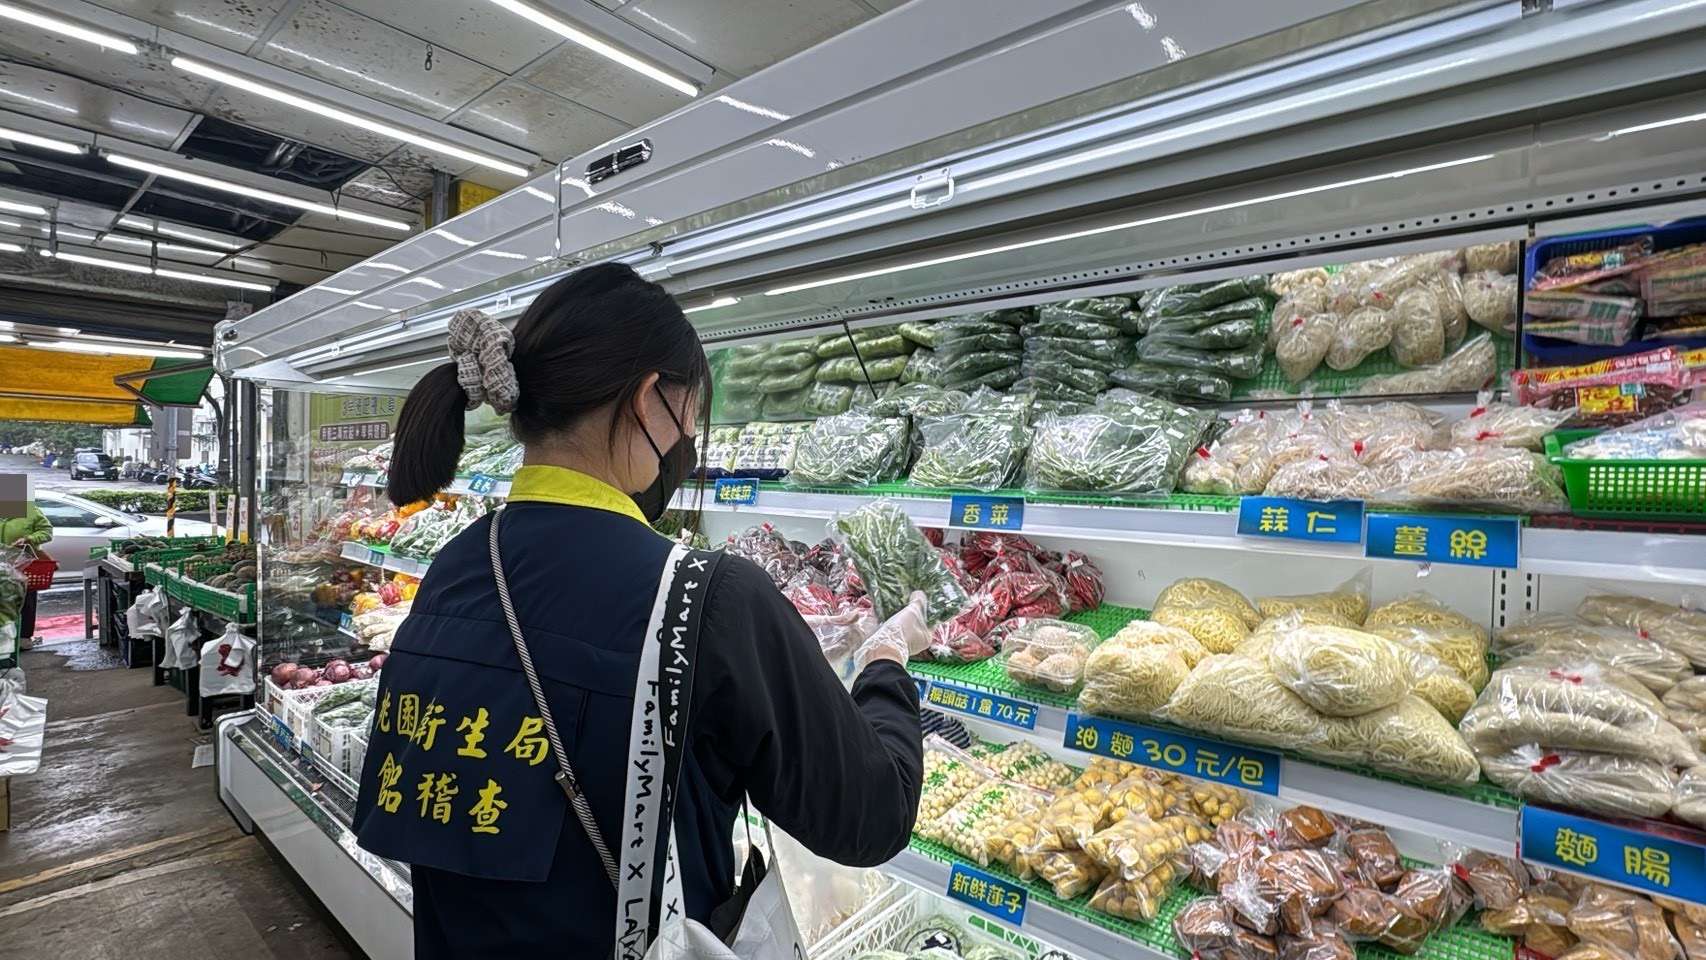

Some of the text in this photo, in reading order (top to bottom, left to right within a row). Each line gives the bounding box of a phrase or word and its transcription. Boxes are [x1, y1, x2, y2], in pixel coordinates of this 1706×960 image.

[962, 504, 1009, 525] 香菜
[1260, 507, 1337, 534] 蒜仁
[1394, 526, 1488, 560] 薑絲
[664, 580, 699, 748] FamilyMart
[630, 679, 660, 849] FamilyMart
[1554, 827, 1671, 888] 麵腸
[952, 871, 1023, 914] 新鮮蓮子
